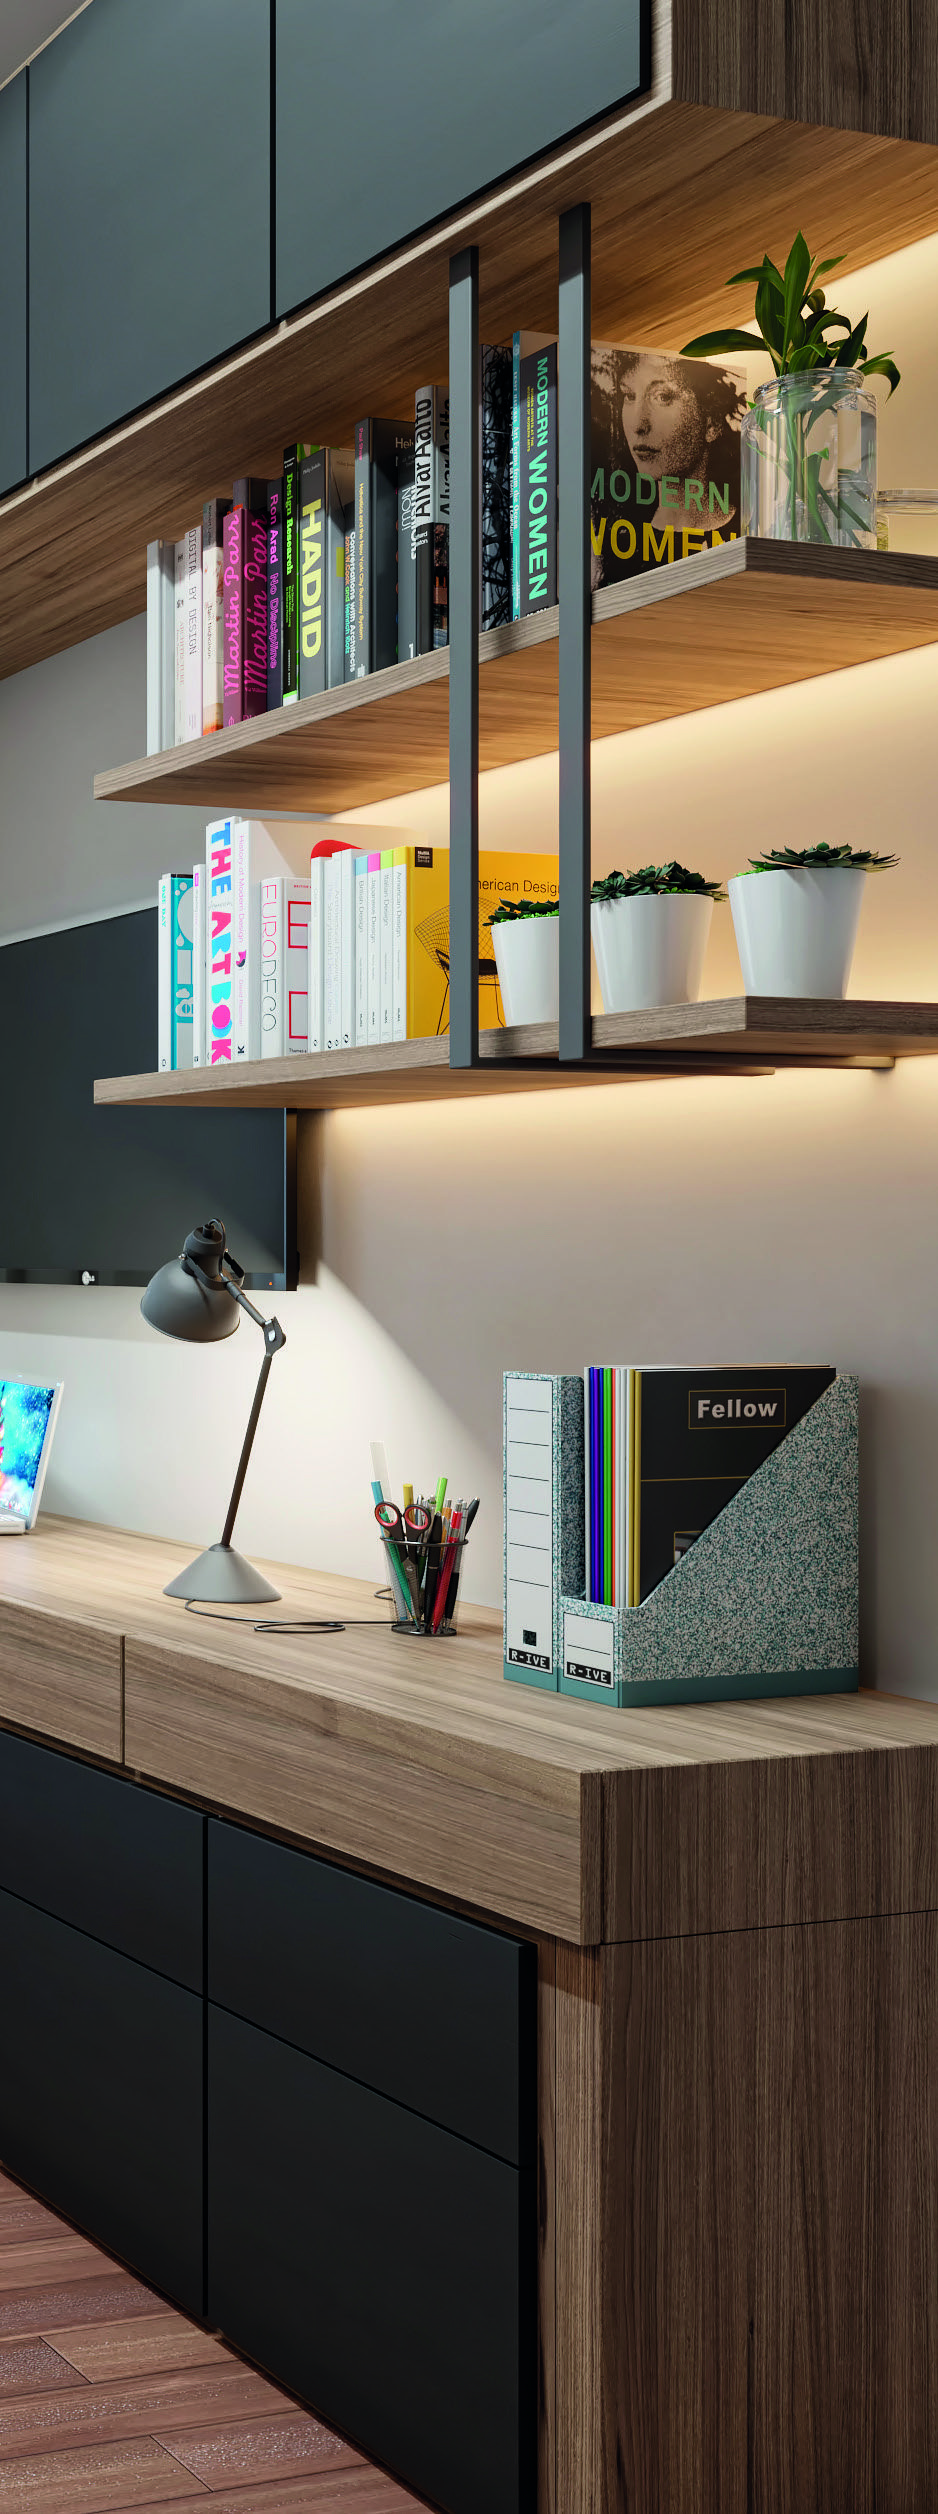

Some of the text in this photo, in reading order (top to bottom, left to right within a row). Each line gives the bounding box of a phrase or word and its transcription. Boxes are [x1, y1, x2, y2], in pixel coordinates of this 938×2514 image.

[415, 398, 431, 458] Aalto
[537, 357, 548, 447] MODERN
[285, 472, 294, 516] Design
[401, 487, 412, 530] NOW!
[416, 462, 431, 517] Alvar
[224, 514, 240, 587] Parr
[243, 514, 268, 582] Parr
[285, 517, 294, 576] Research
[529, 449, 548, 601] WOMEN
[188, 530, 198, 655] DIGITAL BY DESIGN
[268, 494, 279, 669] Ron Arad No Discipline
[301, 498, 322, 658] HADID
[224, 590, 240, 690] Martin
[243, 590, 268, 689] Martin
[211, 821, 232, 897] THE
[237, 835, 245, 865] History
[382, 900, 390, 927] Design
[523, 879, 560, 897] Desig
[211, 911, 232, 975] ART
[237, 913, 245, 943] Design
[357, 906, 365, 933] Design
[211, 981, 233, 1066] BOOK
[697, 1398, 778, 1419] Fellow
[511, 1650, 547, 1668] R-IVE
[569, 1663, 608, 1682] R-IVE
